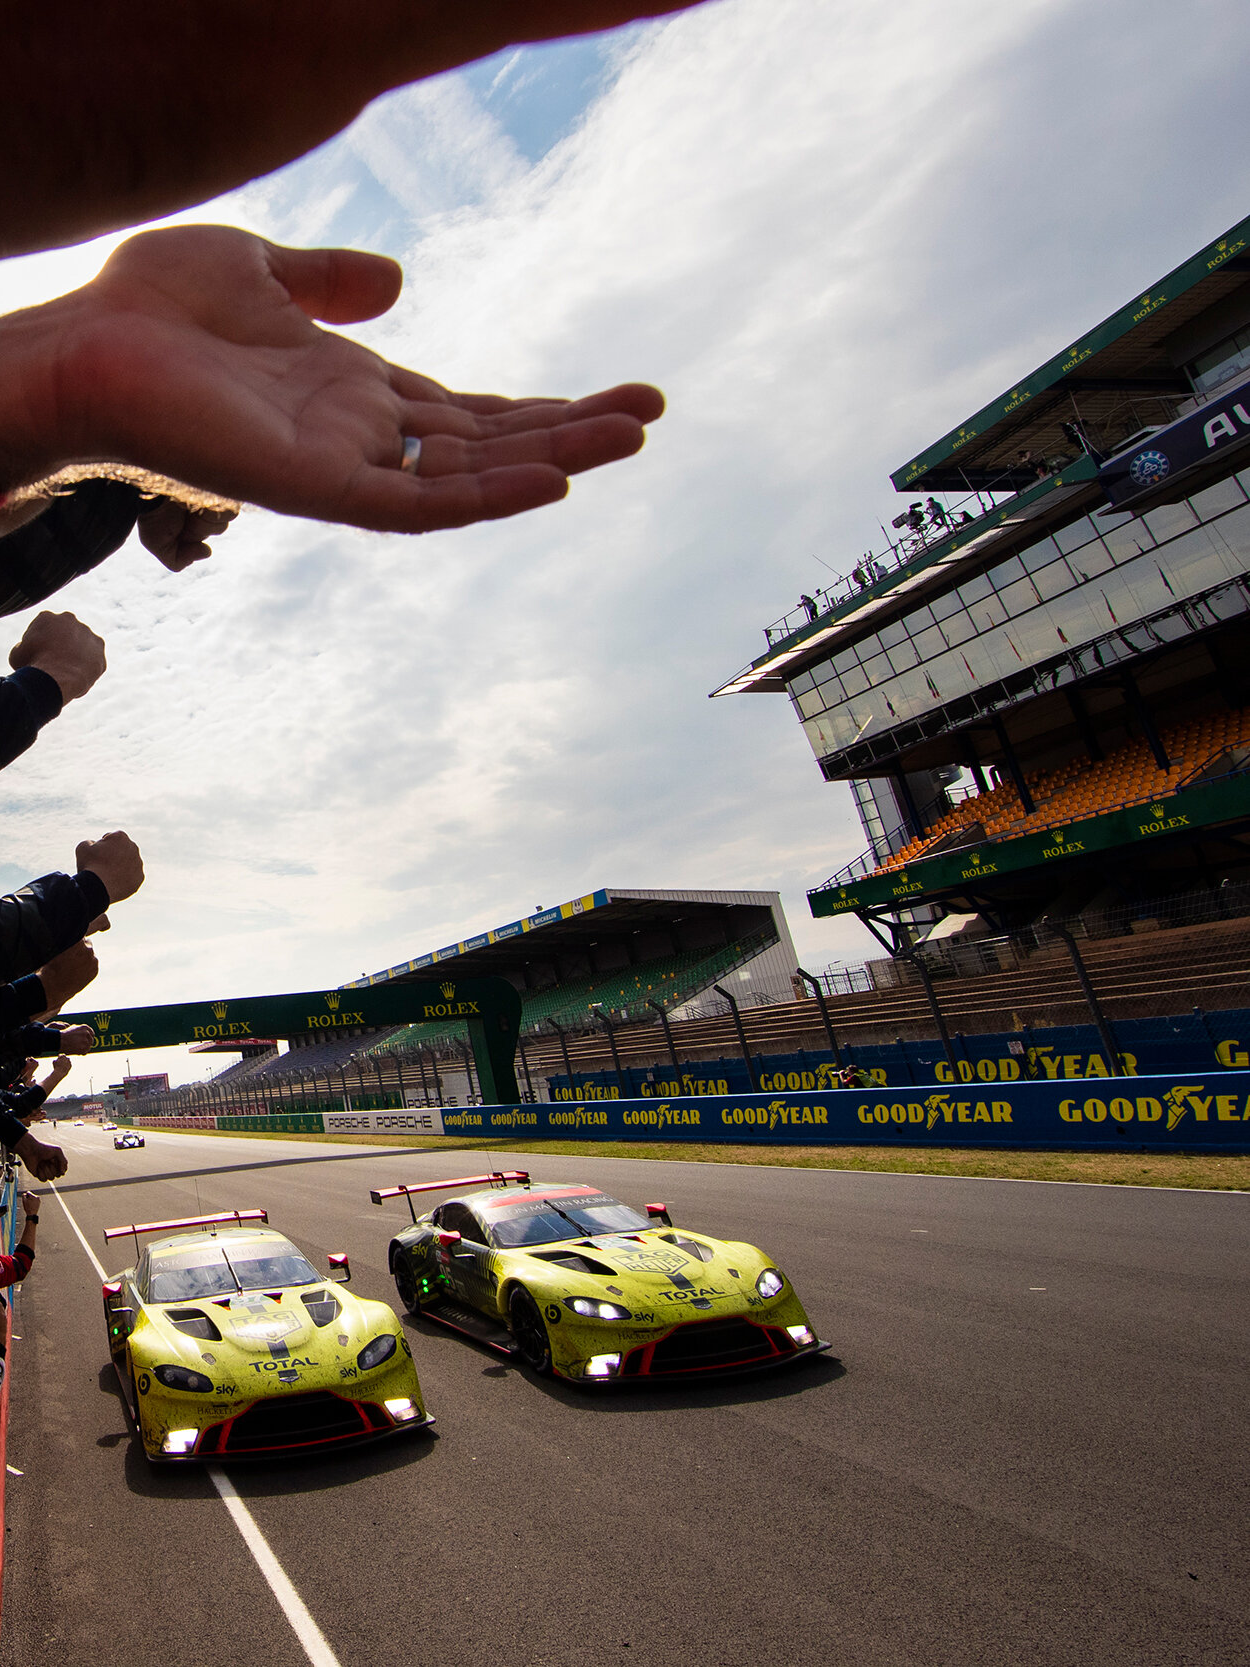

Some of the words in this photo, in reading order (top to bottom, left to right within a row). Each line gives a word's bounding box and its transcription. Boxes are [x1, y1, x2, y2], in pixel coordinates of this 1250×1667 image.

[1206, 239, 1246, 269] ROLEX
[1132, 295, 1167, 322] ROLEX
[1061, 348, 1092, 372] ROLEX
[1004, 391, 1031, 413] ROLEX
[952, 430, 977, 449] ROLEX
[905, 463, 928, 482] ROLEX
[1138, 814, 1190, 835] ROLEX
[1042, 841, 1086, 859] ROLEX
[961, 863, 998, 879] ROLEX
[892, 881, 924, 896] ROLEX
[832, 897, 860, 911] ROLEX
[534, 911, 558, 926] MICHELIN
[423, 1001, 480, 1018] ROLEX
[307, 1011, 365, 1028] ROLEX
[193, 1021, 252, 1039] ROLEX
[91, 1032, 135, 1049] OLEX
[444, 1112, 483, 1126] GOODYEAR
[490, 1111, 537, 1126] GOODYEAR
[548, 1110, 608, 1126] GOODYEAR
[623, 1108, 701, 1126] GOODYEAR
[721, 1104, 828, 1126] GOODYEAR
[857, 1099, 1013, 1125] GOODYEAR
[329, 1117, 370, 1129] PORSCHE
[377, 1115, 432, 1129] PORSCHE
[572, 1195, 614, 1207] RACING
[411, 1243, 428, 1260] sky
[619, 1250, 671, 1261] TAG
[630, 1256, 684, 1273] HEUER
[658, 1286, 725, 1301] TOTAL
[634, 1311, 655, 1323] sky
[248, 1356, 319, 1373] TOTAL
[339, 1366, 358, 1379] sky
[215, 1383, 236, 1397] sky
